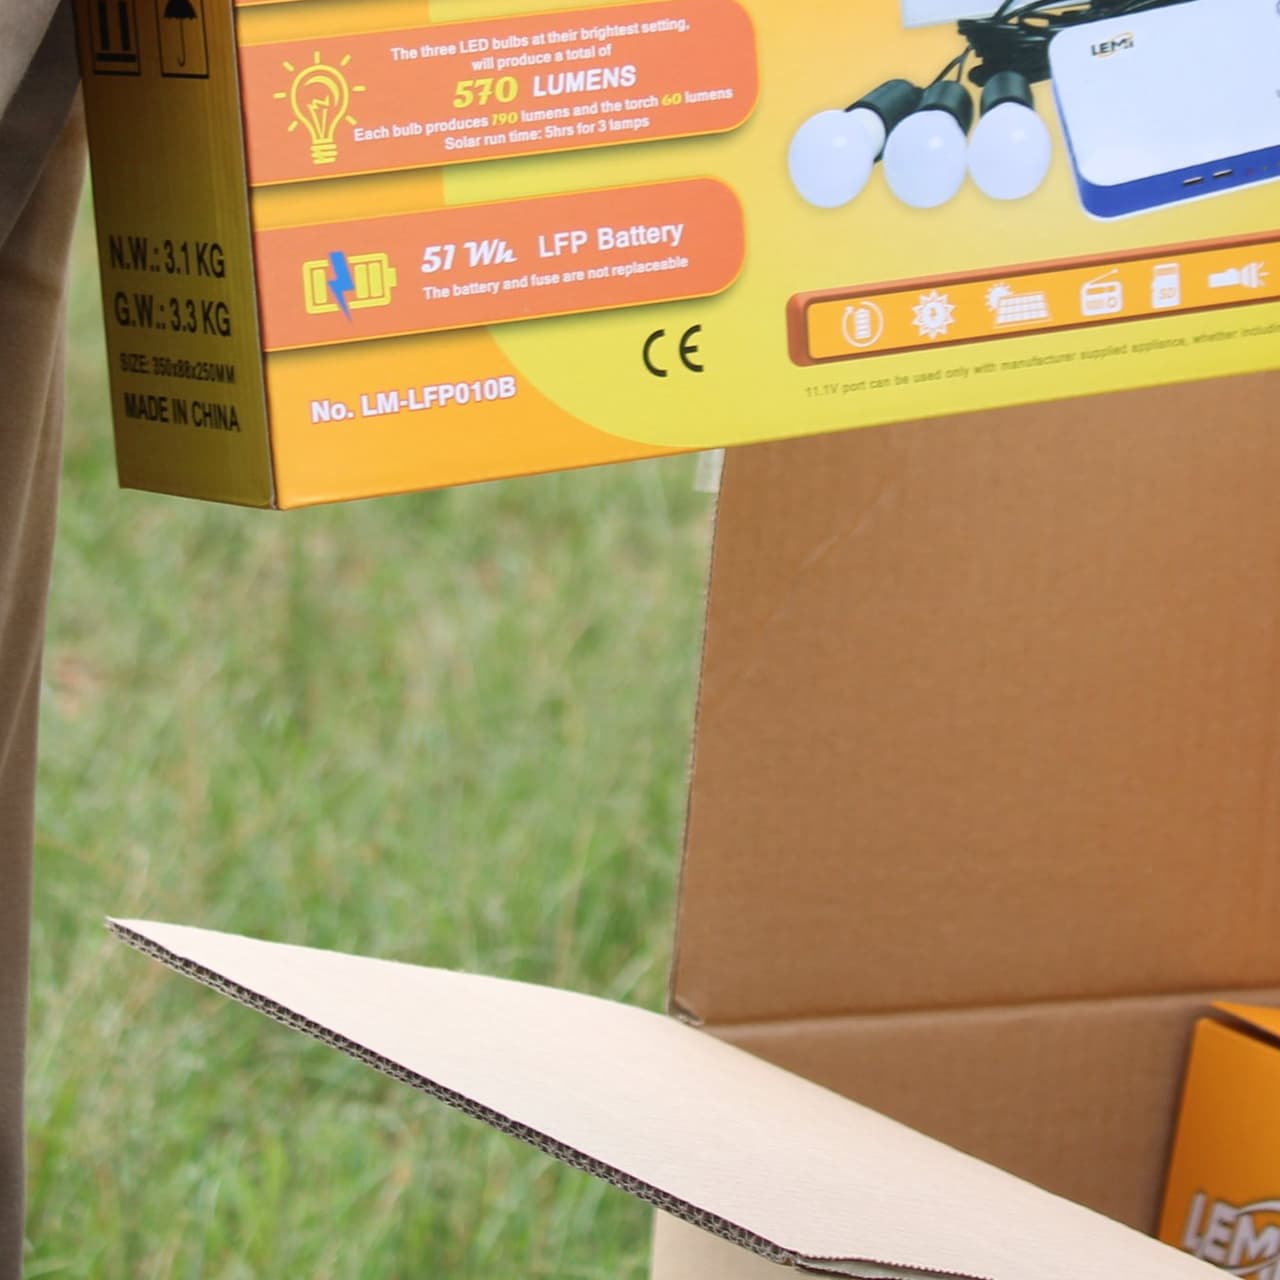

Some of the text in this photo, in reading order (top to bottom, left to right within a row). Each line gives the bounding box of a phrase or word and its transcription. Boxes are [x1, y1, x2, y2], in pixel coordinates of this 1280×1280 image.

[390, 17, 690, 62] The three LED bulbs at their brightest setting,
[471, 42, 613, 72] will produce a total of
[452, 64, 637, 110] 570 LUMENS
[353, 124, 390, 143] Each
[392, 119, 423, 138] bulb
[425, 114, 489, 138] produces
[521, 105, 571, 124] lumens
[572, 100, 599, 119] and
[601, 97, 622, 114] the
[624, 94, 659, 113] torch
[661, 92, 682, 108] 60
[684, 88, 733, 105] lumens
[443, 115, 650, 152] Solar run time: 5hrs for 3 lamps
[163, 239, 190, 275] 3.1
[196, 241, 226, 279] KG
[538, 230, 587, 259] LFP
[596, 223, 684, 254] Battery
[422, 255, 689, 300] The battery and fuse are not replaceable
[169, 297, 198, 333] 3.3
[201, 299, 232, 337] KG
[310, 375, 517, 424] No. LM-LFP010B
[842, 379, 866, 395] port
[870, 377, 891, 389] can
[894, 373, 909, 387] be
[913, 369, 942, 384] used
[945, 365, 969, 381] only
[124, 391, 241, 433] MADE IN CHINA
